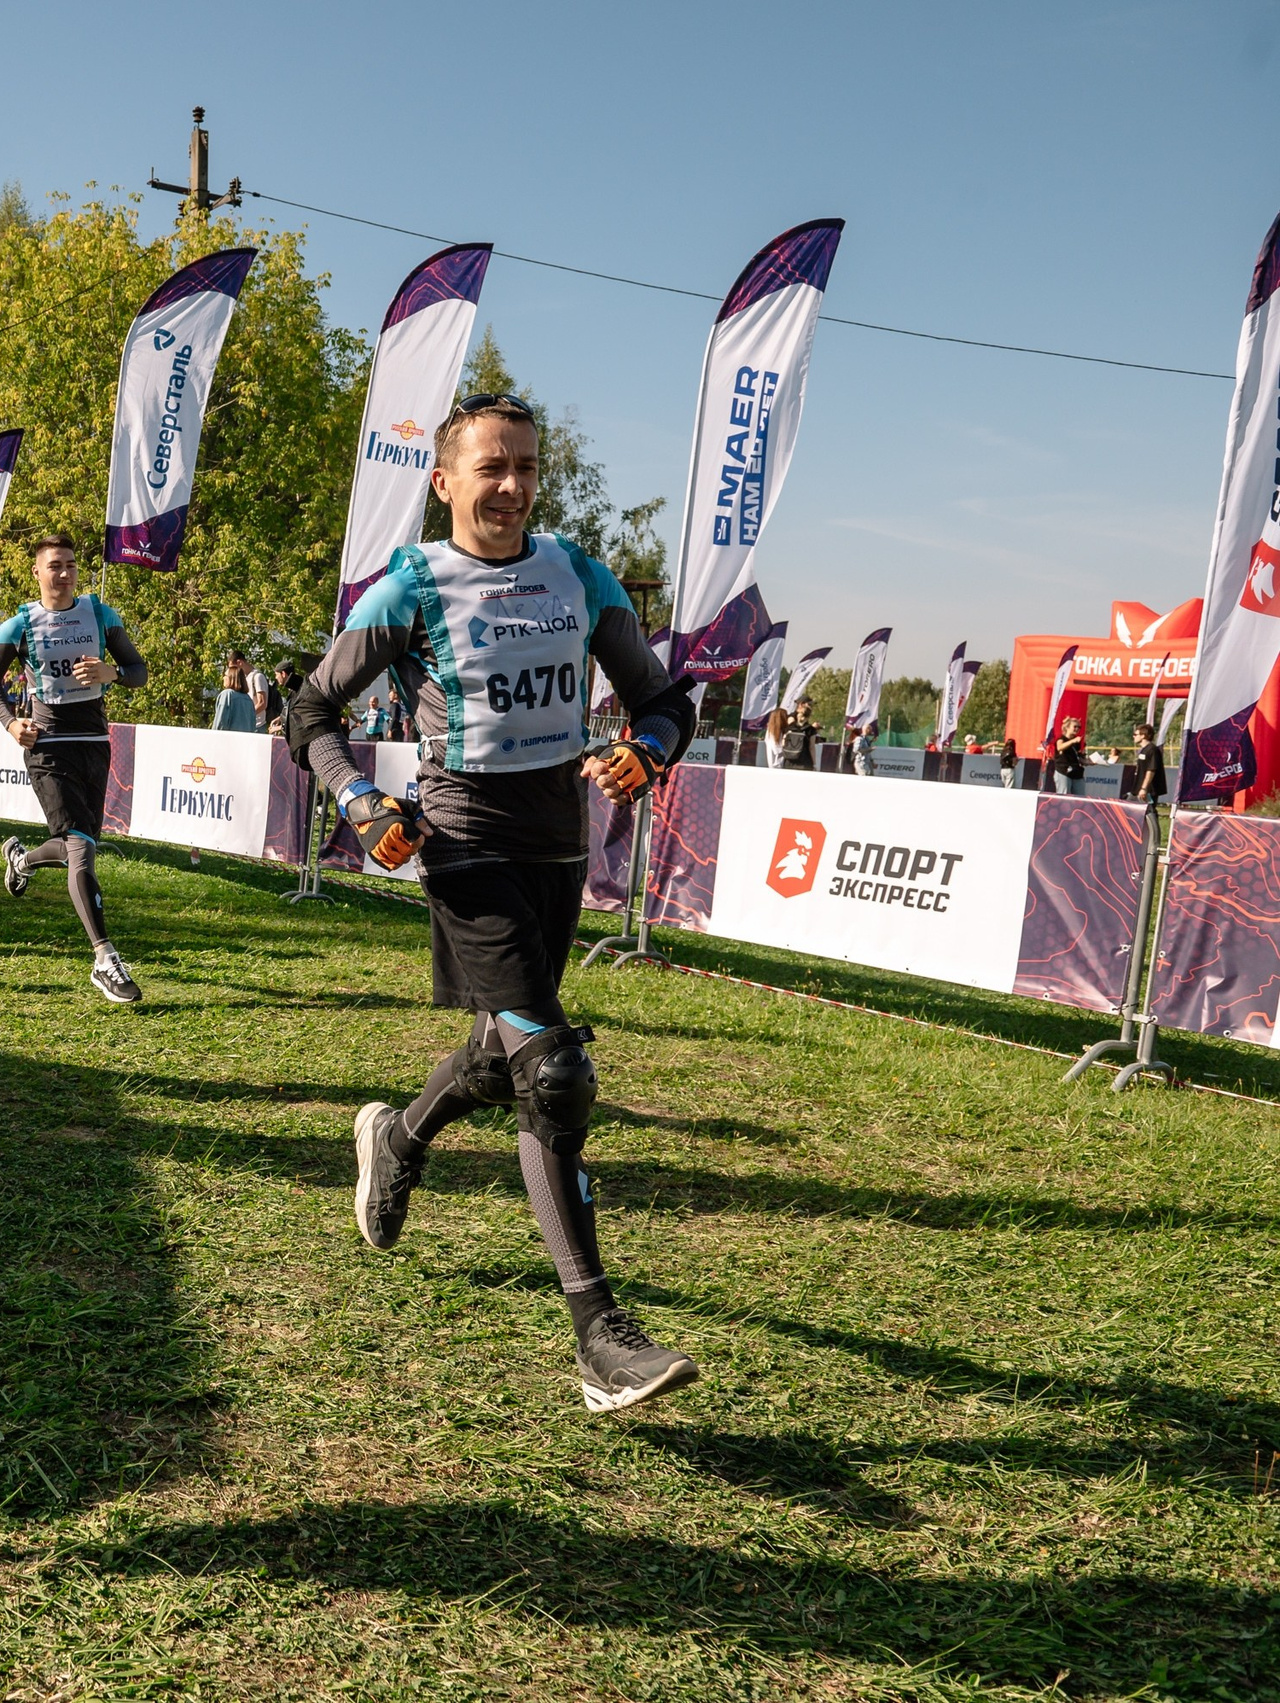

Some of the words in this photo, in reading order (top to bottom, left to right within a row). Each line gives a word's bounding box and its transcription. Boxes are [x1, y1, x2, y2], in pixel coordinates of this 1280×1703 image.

[147, 344, 192, 489] Северсталь
[717, 365, 759, 508] MAER
[366, 431, 431, 470] ГЕРКУЛЕ
[480, 586, 513, 598] ГОНКА
[514, 583, 546, 593] ГЕРОЕВ
[494, 615, 578, 641] РТК-ЦОД
[54, 635, 93, 647] РТК-ЦОД
[50, 657, 84, 678] 58
[486, 662, 576, 714] 6470
[520, 731, 569, 748] ГАЗПРОМБАНК
[687, 751, 709, 761] OCR
[880, 764, 915, 772] TORERO
[970, 770, 1002, 781] Северста
[1084, 775, 1118, 785] ЗПРОМБАНК
[836, 840, 963, 886] СПОРТ
[829, 876, 950, 912] ЭКСПРЕСС
